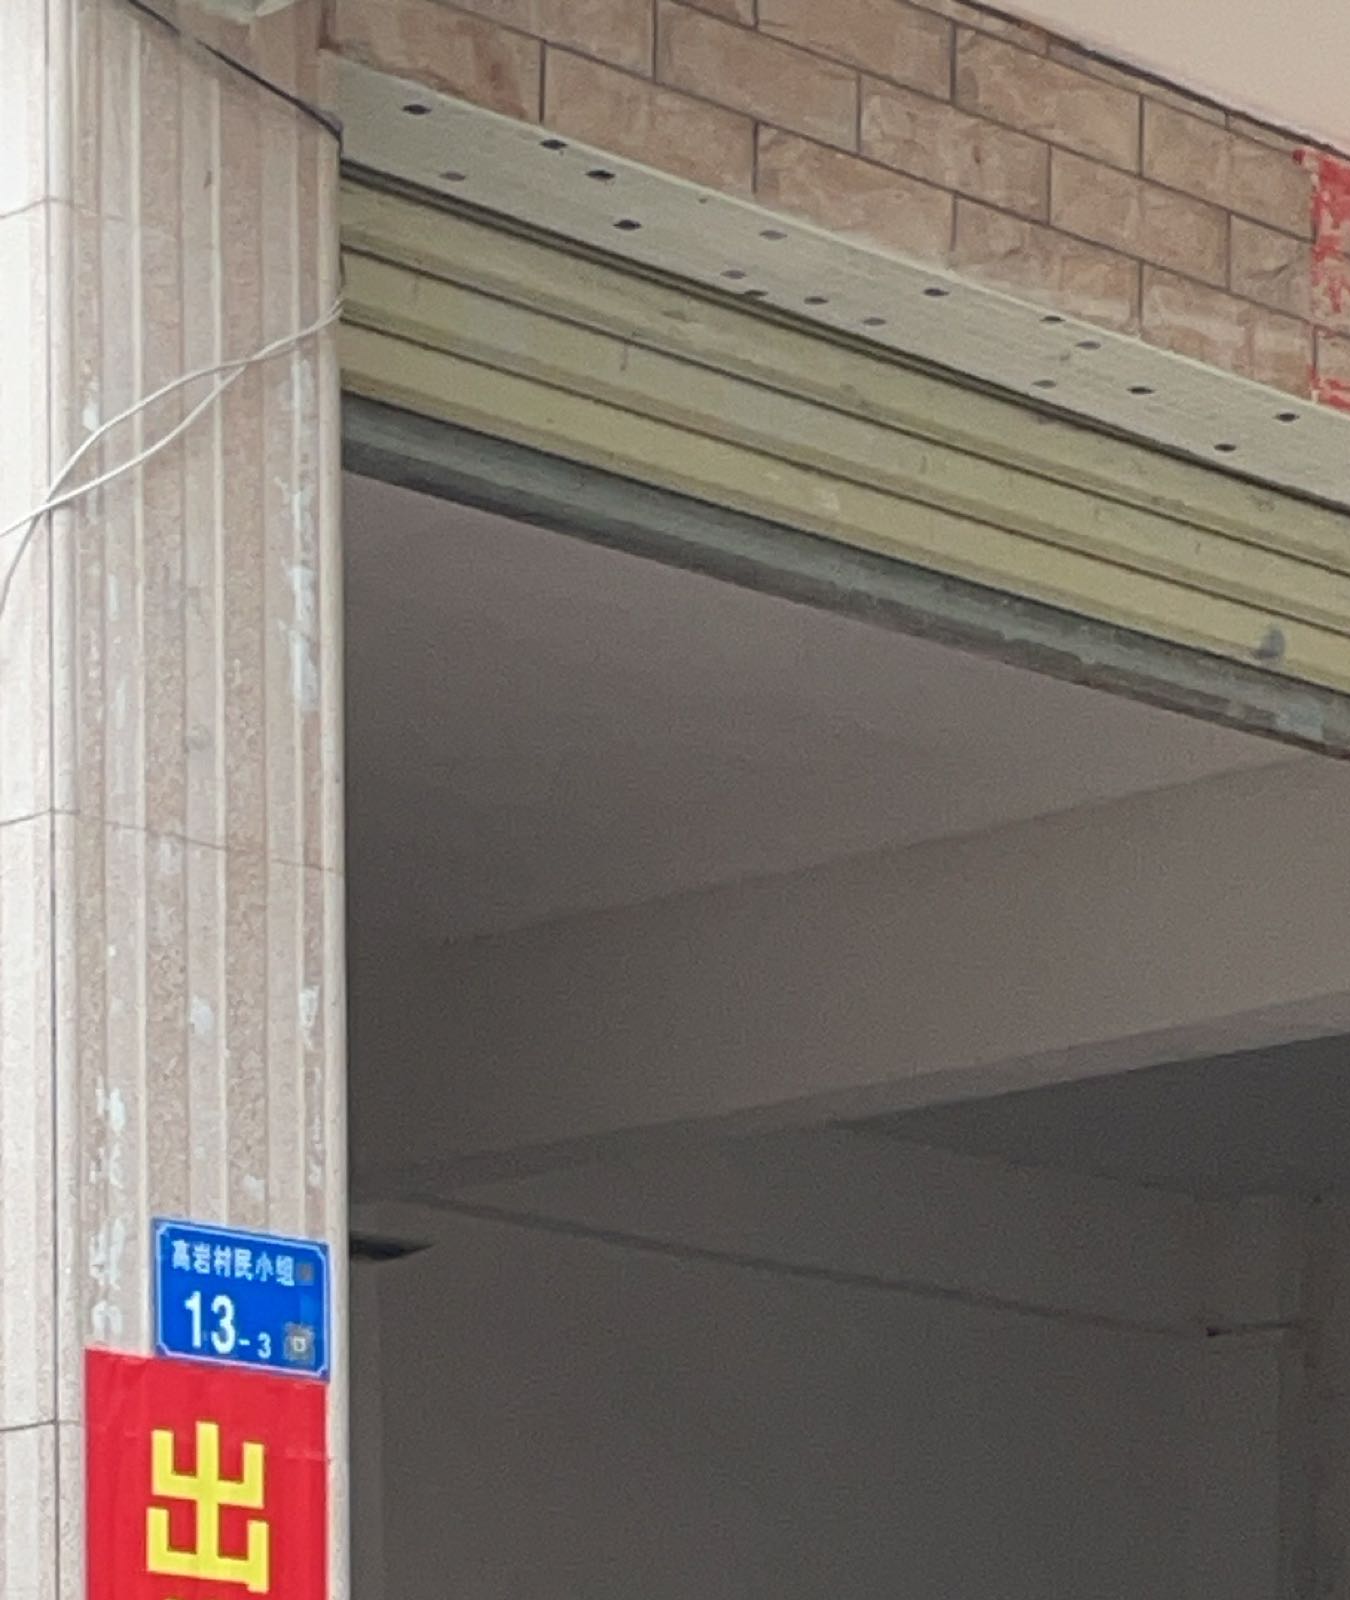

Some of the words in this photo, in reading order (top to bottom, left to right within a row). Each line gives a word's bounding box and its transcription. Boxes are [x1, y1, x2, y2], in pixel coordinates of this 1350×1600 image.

[171, 1238, 296, 1287] 高岩村民小组
